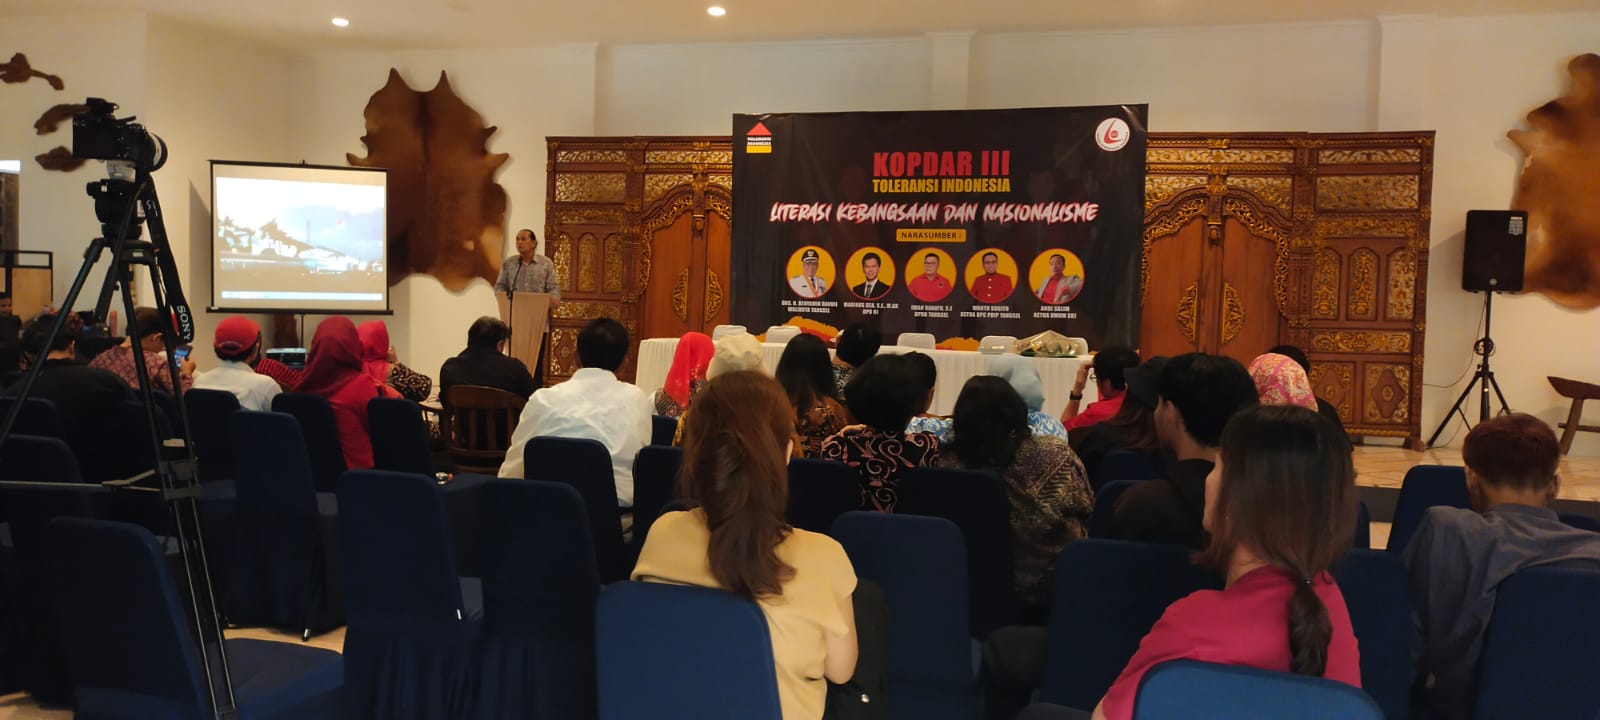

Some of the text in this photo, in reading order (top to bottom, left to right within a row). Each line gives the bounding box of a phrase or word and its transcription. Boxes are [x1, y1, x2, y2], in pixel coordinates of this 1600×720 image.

[873, 150, 1010, 177] KOPDAR III
[872, 178, 1011, 193] TOLERANSI INDONESIA
[769, 201, 1099, 225] LITERASI KEBANGSAAN DAN NASIONALISME
[177, 305, 191, 340] SONY
